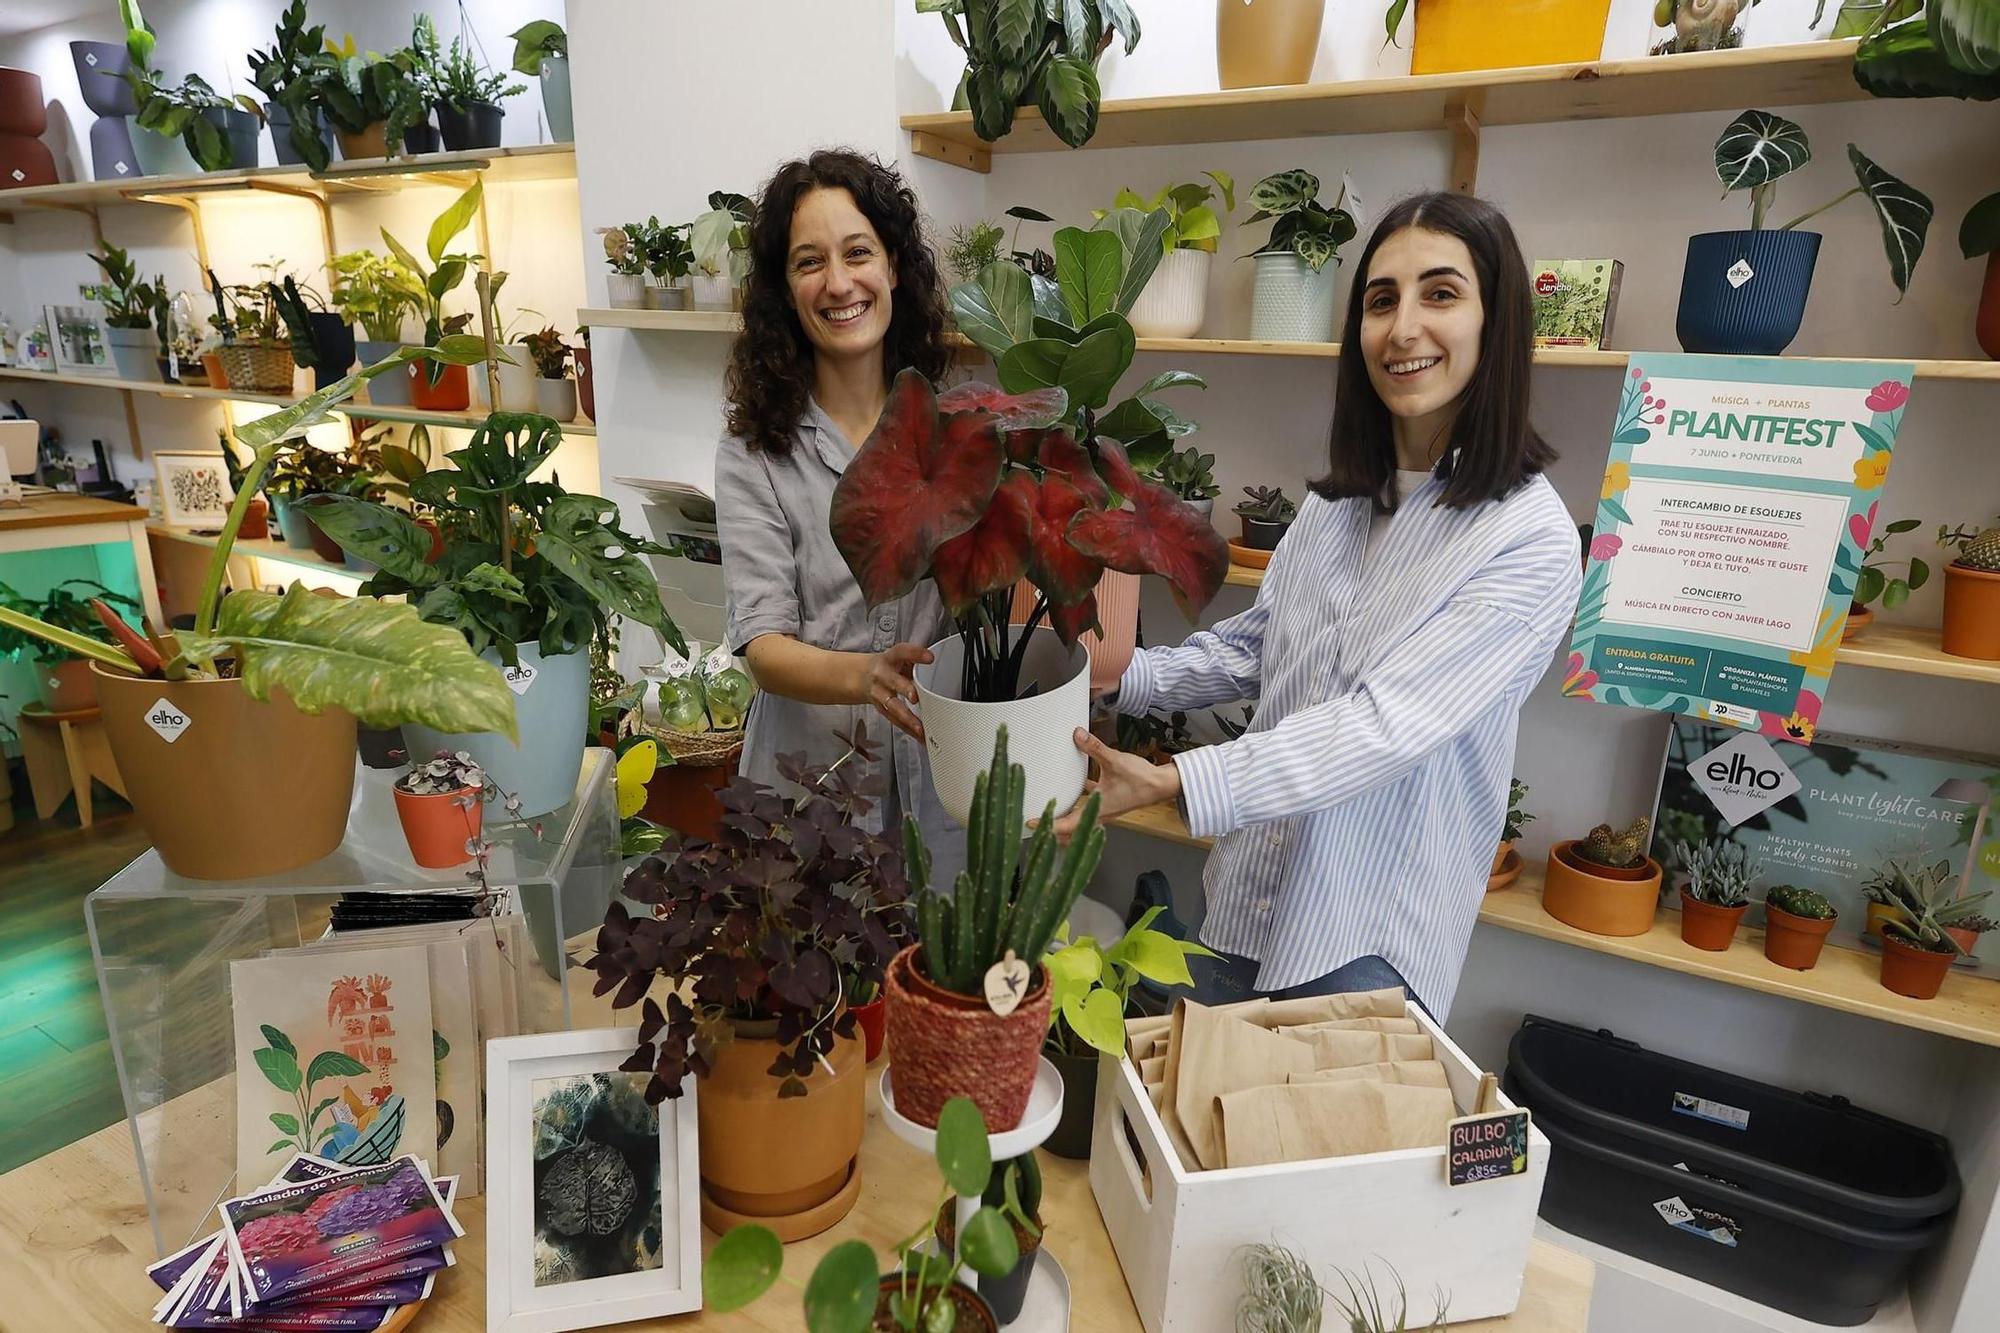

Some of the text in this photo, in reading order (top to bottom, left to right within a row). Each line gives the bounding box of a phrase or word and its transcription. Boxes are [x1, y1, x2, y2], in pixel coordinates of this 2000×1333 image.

[1730, 266, 1749, 277] elho
[1540, 282, 1572, 292] Jericho
[1768, 399, 1811, 410] PLANTAS
[1667, 409, 1846, 448] PLANTFEST
[1698, 449, 1729, 459] JUNIO
[1739, 452, 1803, 465] PONTEVEDRA
[1660, 498, 1802, 521] INTERCAMBIO DE ESQUEJES
[1658, 529, 1791, 551] CON SU RESPECTIVO NOMBRE.
[1660, 519, 1790, 542] TRAE TU ESQUEJE ENRAIZADO,
[1632, 543, 1808, 573] CÁMBIALO POR OTRO QUE MÁS TE GUSTE
[1690, 560, 1711, 569] DEJA
[1713, 562, 1723, 570] EL
[1725, 564, 1751, 575] TUYO.
[1681, 586, 1742, 602] CONCIERTO
[1659, 603, 1671, 611] EN
[1673, 605, 1709, 616] DIRECTO
[1712, 610, 1732, 620] CON
[1734, 613, 1765, 625] JAVIER
[1766, 619, 1791, 630] LAGO
[1605, 647, 1695, 666] ENTRADA GRATUITA
[506, 667, 532, 681] elho
[1723, 665, 1788, 684] ORGANIZA: PLÁNTATE
[152, 709, 184, 725] elho
[1706, 753, 1781, 790] elho
[1809, 788, 1965, 824] PLANT light CARE
[1759, 844, 1769, 852] IN
[1810, 855, 1858, 870] CORNERS
[1767, 835, 1851, 857] HEALTHY PLANTS
[1453, 1122, 1506, 1147] BULBO
[239, 1162, 402, 1208] Azulador de Hortensias
[1660, 1203, 1688, 1218] elho
[285, 1272, 326, 1289] PRODUCTOS
[326, 1267, 345, 1276] PARA
[387, 1239, 433, 1257] HORTICULTURA
[269, 1291, 311, 1306] PRODUCTOS
[312, 1287, 331, 1295] PARA
[375, 1266, 423, 1279] HORTICULTURA
[349, 1292, 397, 1301] HORTICULTURA
[203, 1316, 245, 1324] PRODUCTOS
